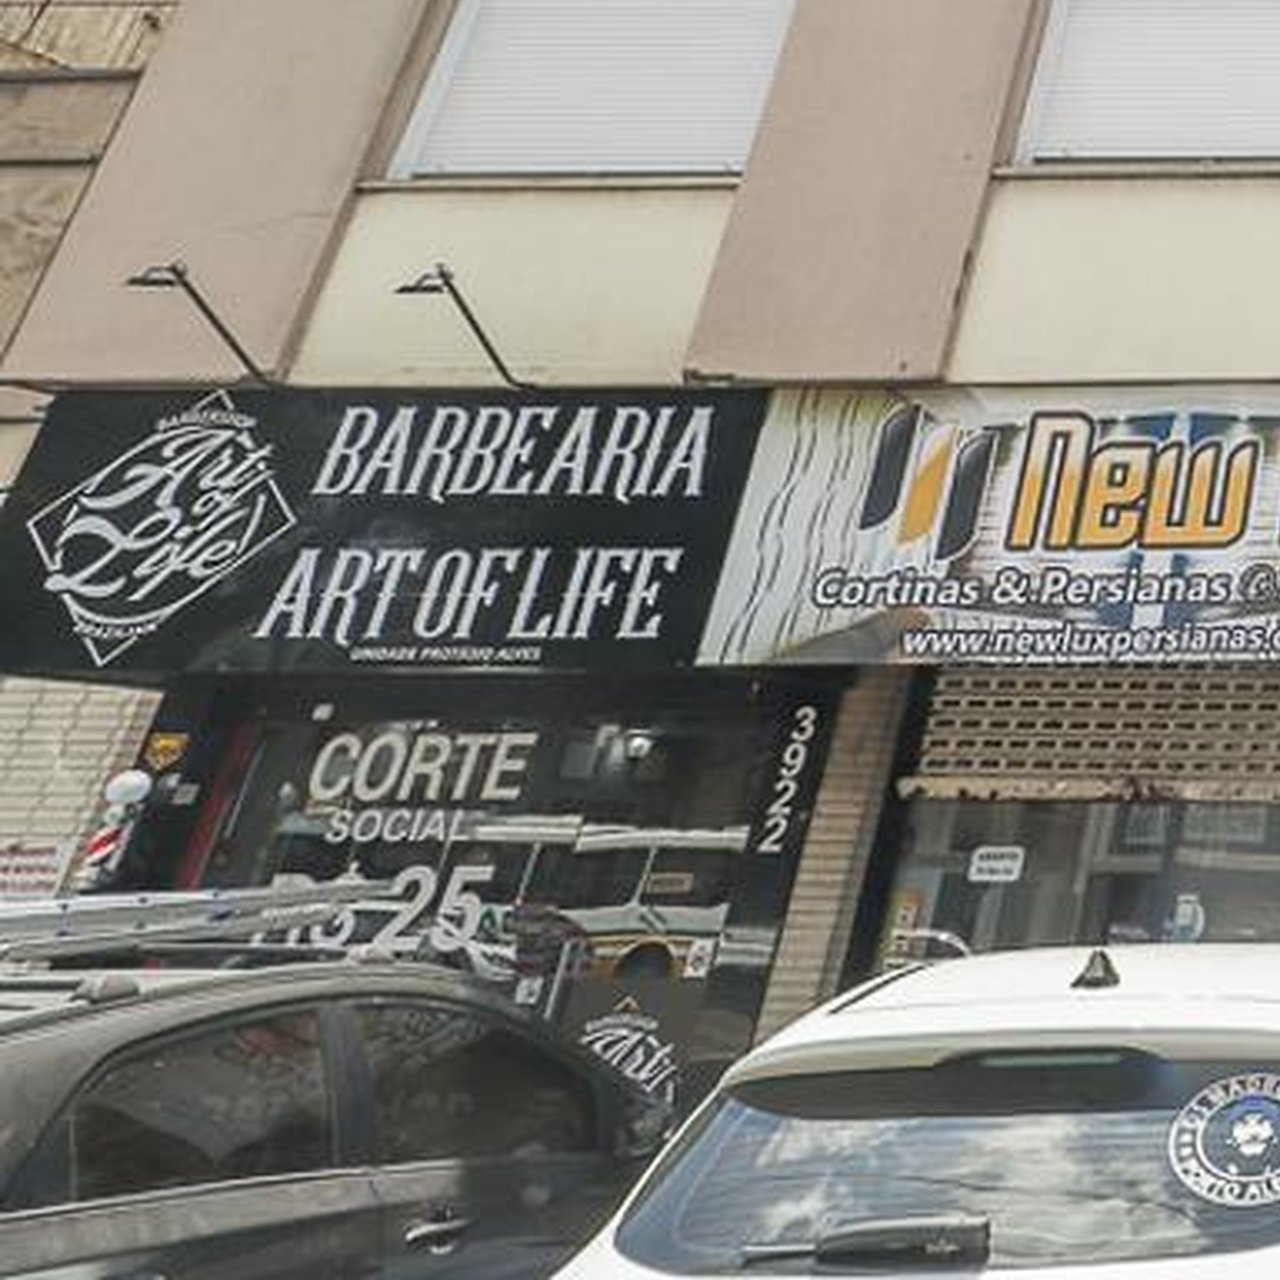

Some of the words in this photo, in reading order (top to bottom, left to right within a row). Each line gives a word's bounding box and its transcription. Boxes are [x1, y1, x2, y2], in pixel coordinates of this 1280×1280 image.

[312, 406, 715, 504] BARBEARIA
[1003, 410, 1261, 551] New
[252, 547, 429, 646] ART
[412, 548, 524, 640] OF
[506, 546, 685, 640] LIFE
[814, 566, 979, 606] Cortinas
[992, 567, 1028, 605] &
[1039, 566, 1232, 605] Persianas
[309, 730, 539, 802] CORTE
[757, 705, 817, 853] 3922
[325, 808, 472, 844] SOCIAL
